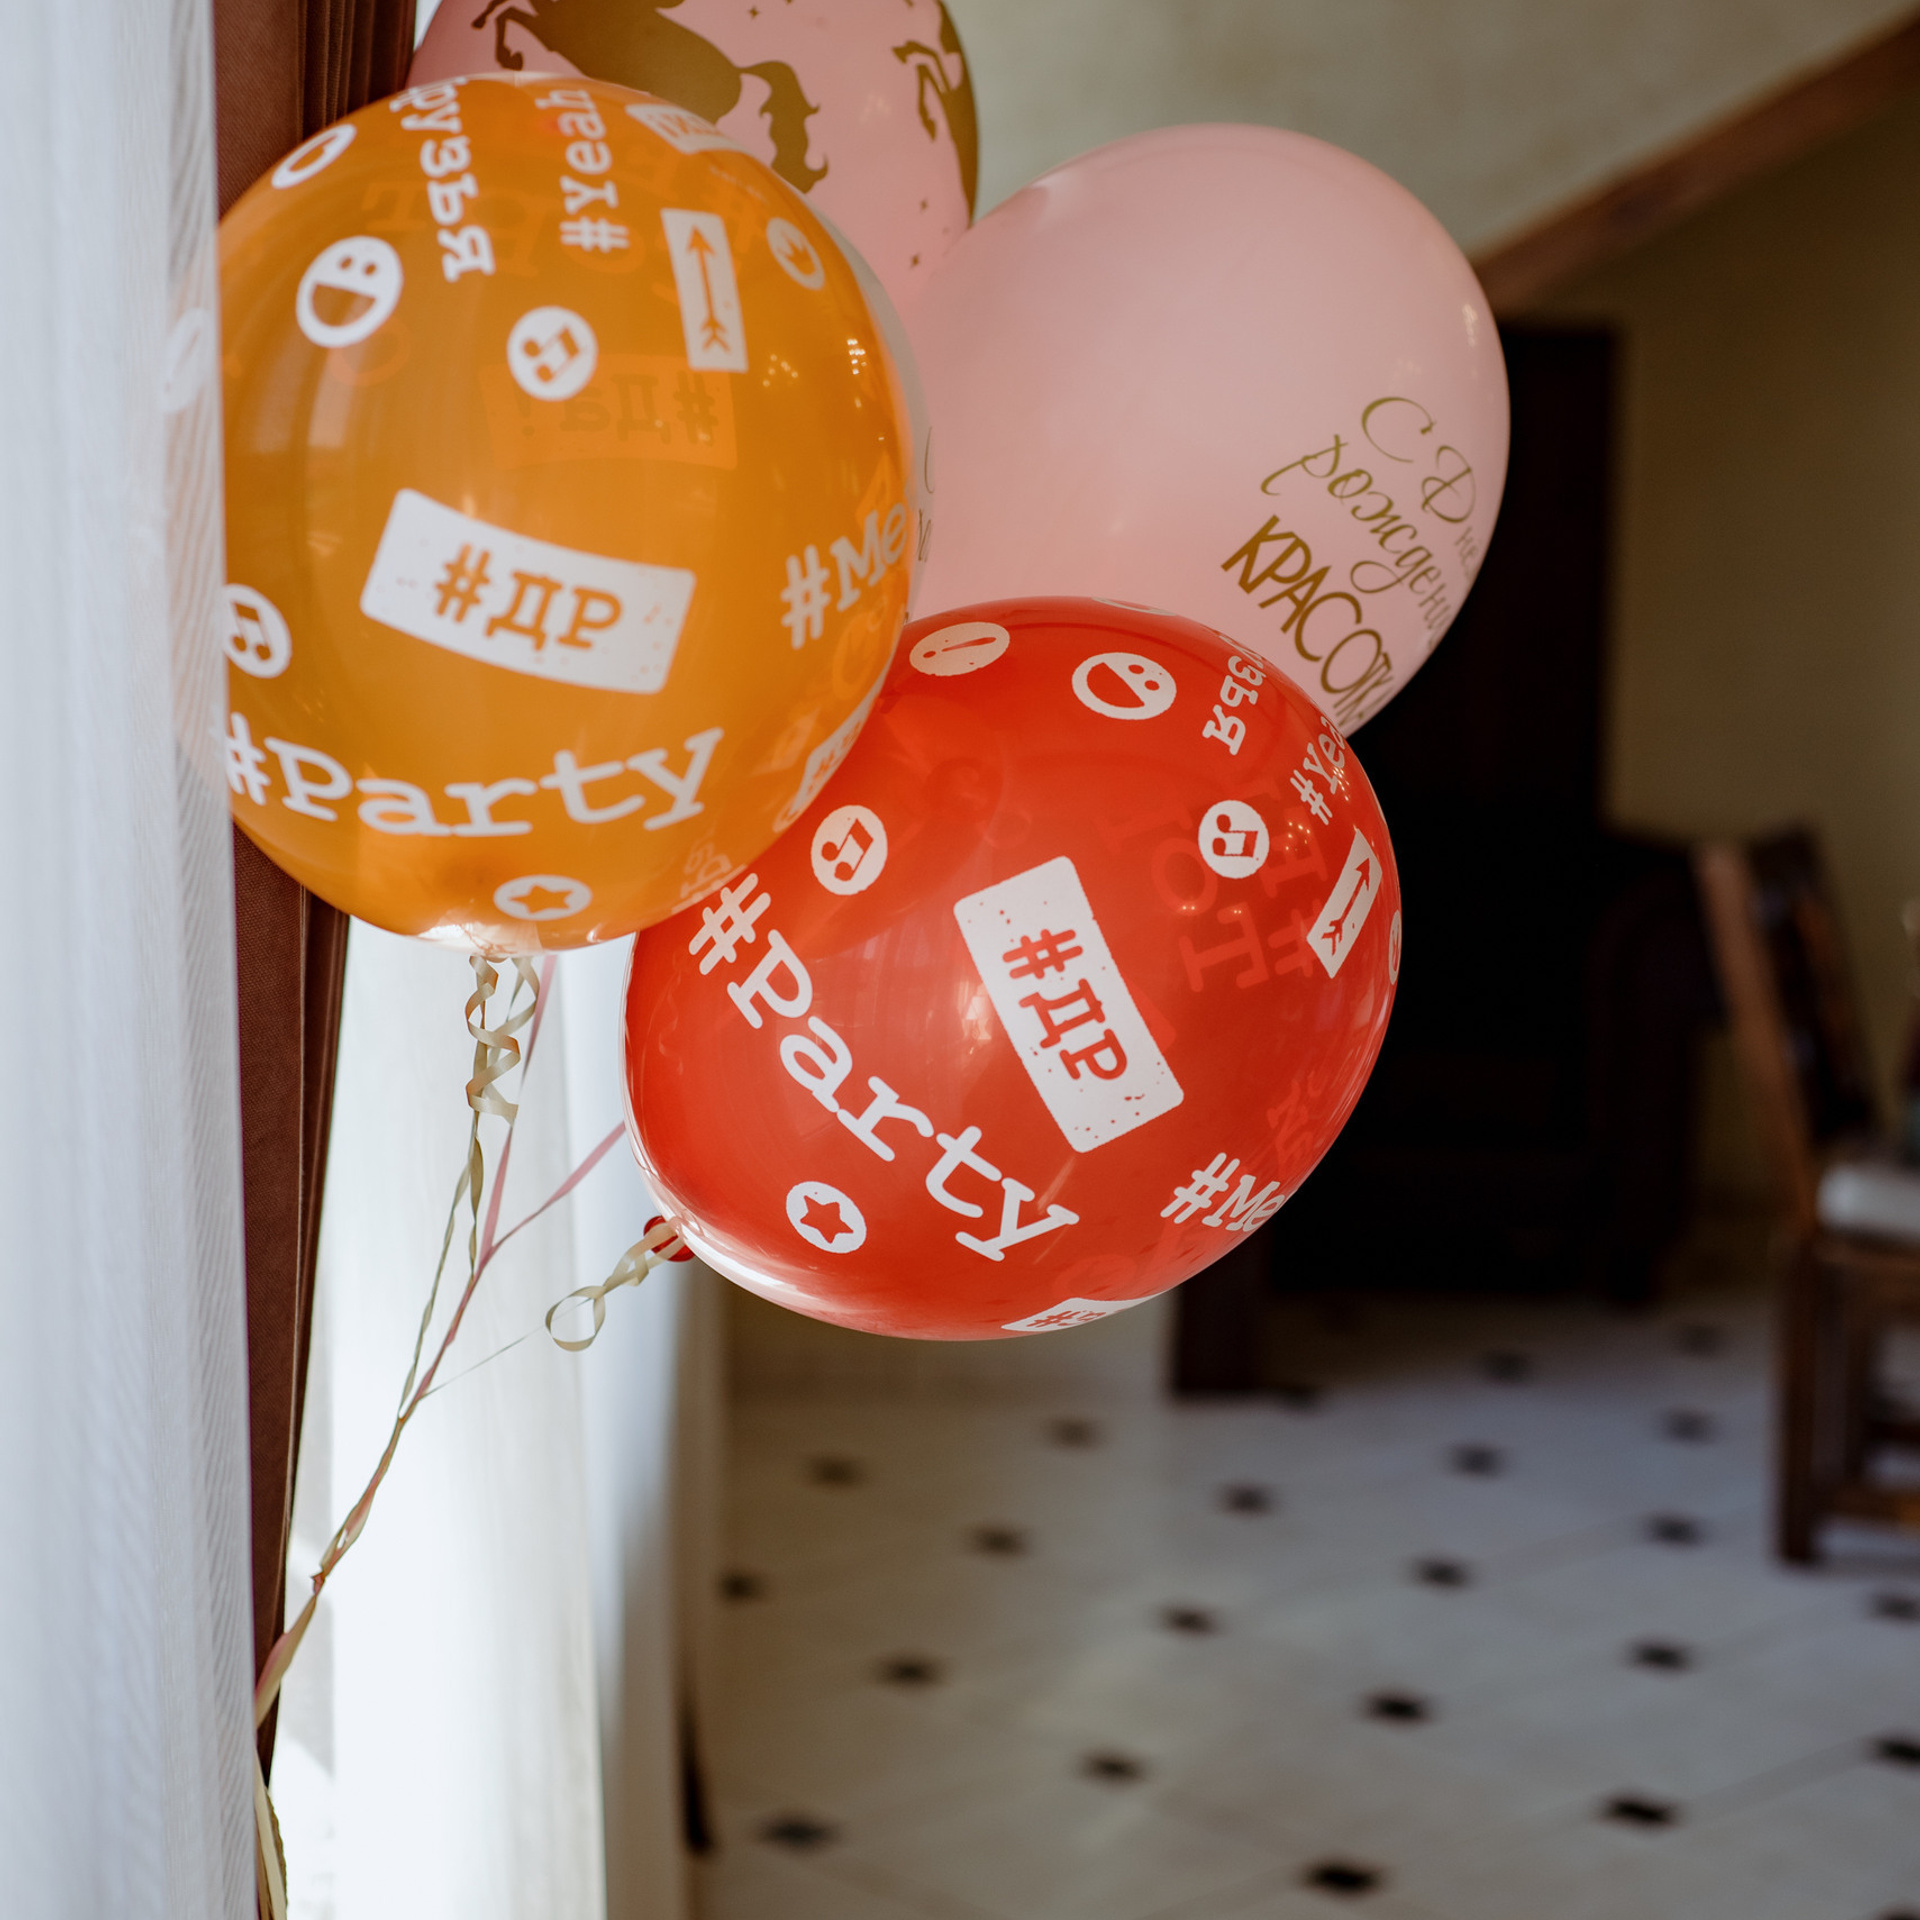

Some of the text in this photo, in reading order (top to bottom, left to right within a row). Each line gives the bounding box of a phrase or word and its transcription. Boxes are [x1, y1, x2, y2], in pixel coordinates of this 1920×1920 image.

[433, 543, 623, 652] #ДР
[222, 711, 723, 837] #Party
[1289, 715, 1347, 826] #Yea
[688, 872, 1080, 1262] #Party
[1002, 927, 1129, 1082] #ДР
